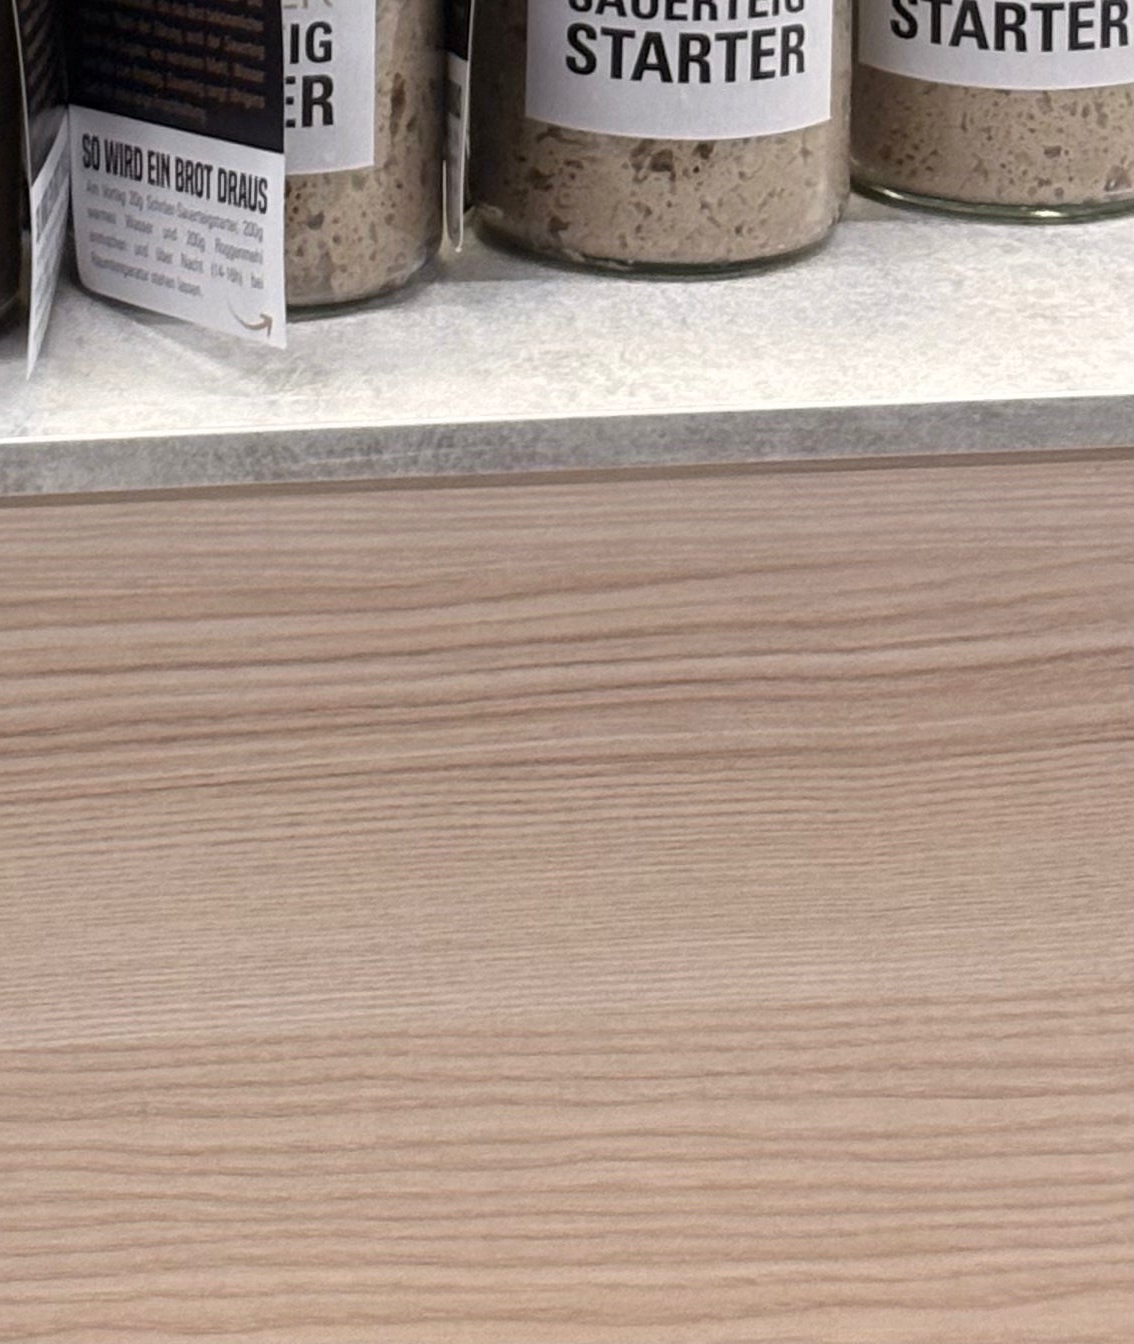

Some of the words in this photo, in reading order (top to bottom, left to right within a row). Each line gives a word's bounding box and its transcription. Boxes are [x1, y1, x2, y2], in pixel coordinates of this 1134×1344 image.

[565, 22, 806, 84] STARTER
[80, 130, 101, 172] SO
[103, 136, 144, 183] WIRD
[145, 147, 171, 191] EIN
[173, 154, 215, 203] BROT
[215, 165, 269, 218] DRAUS
